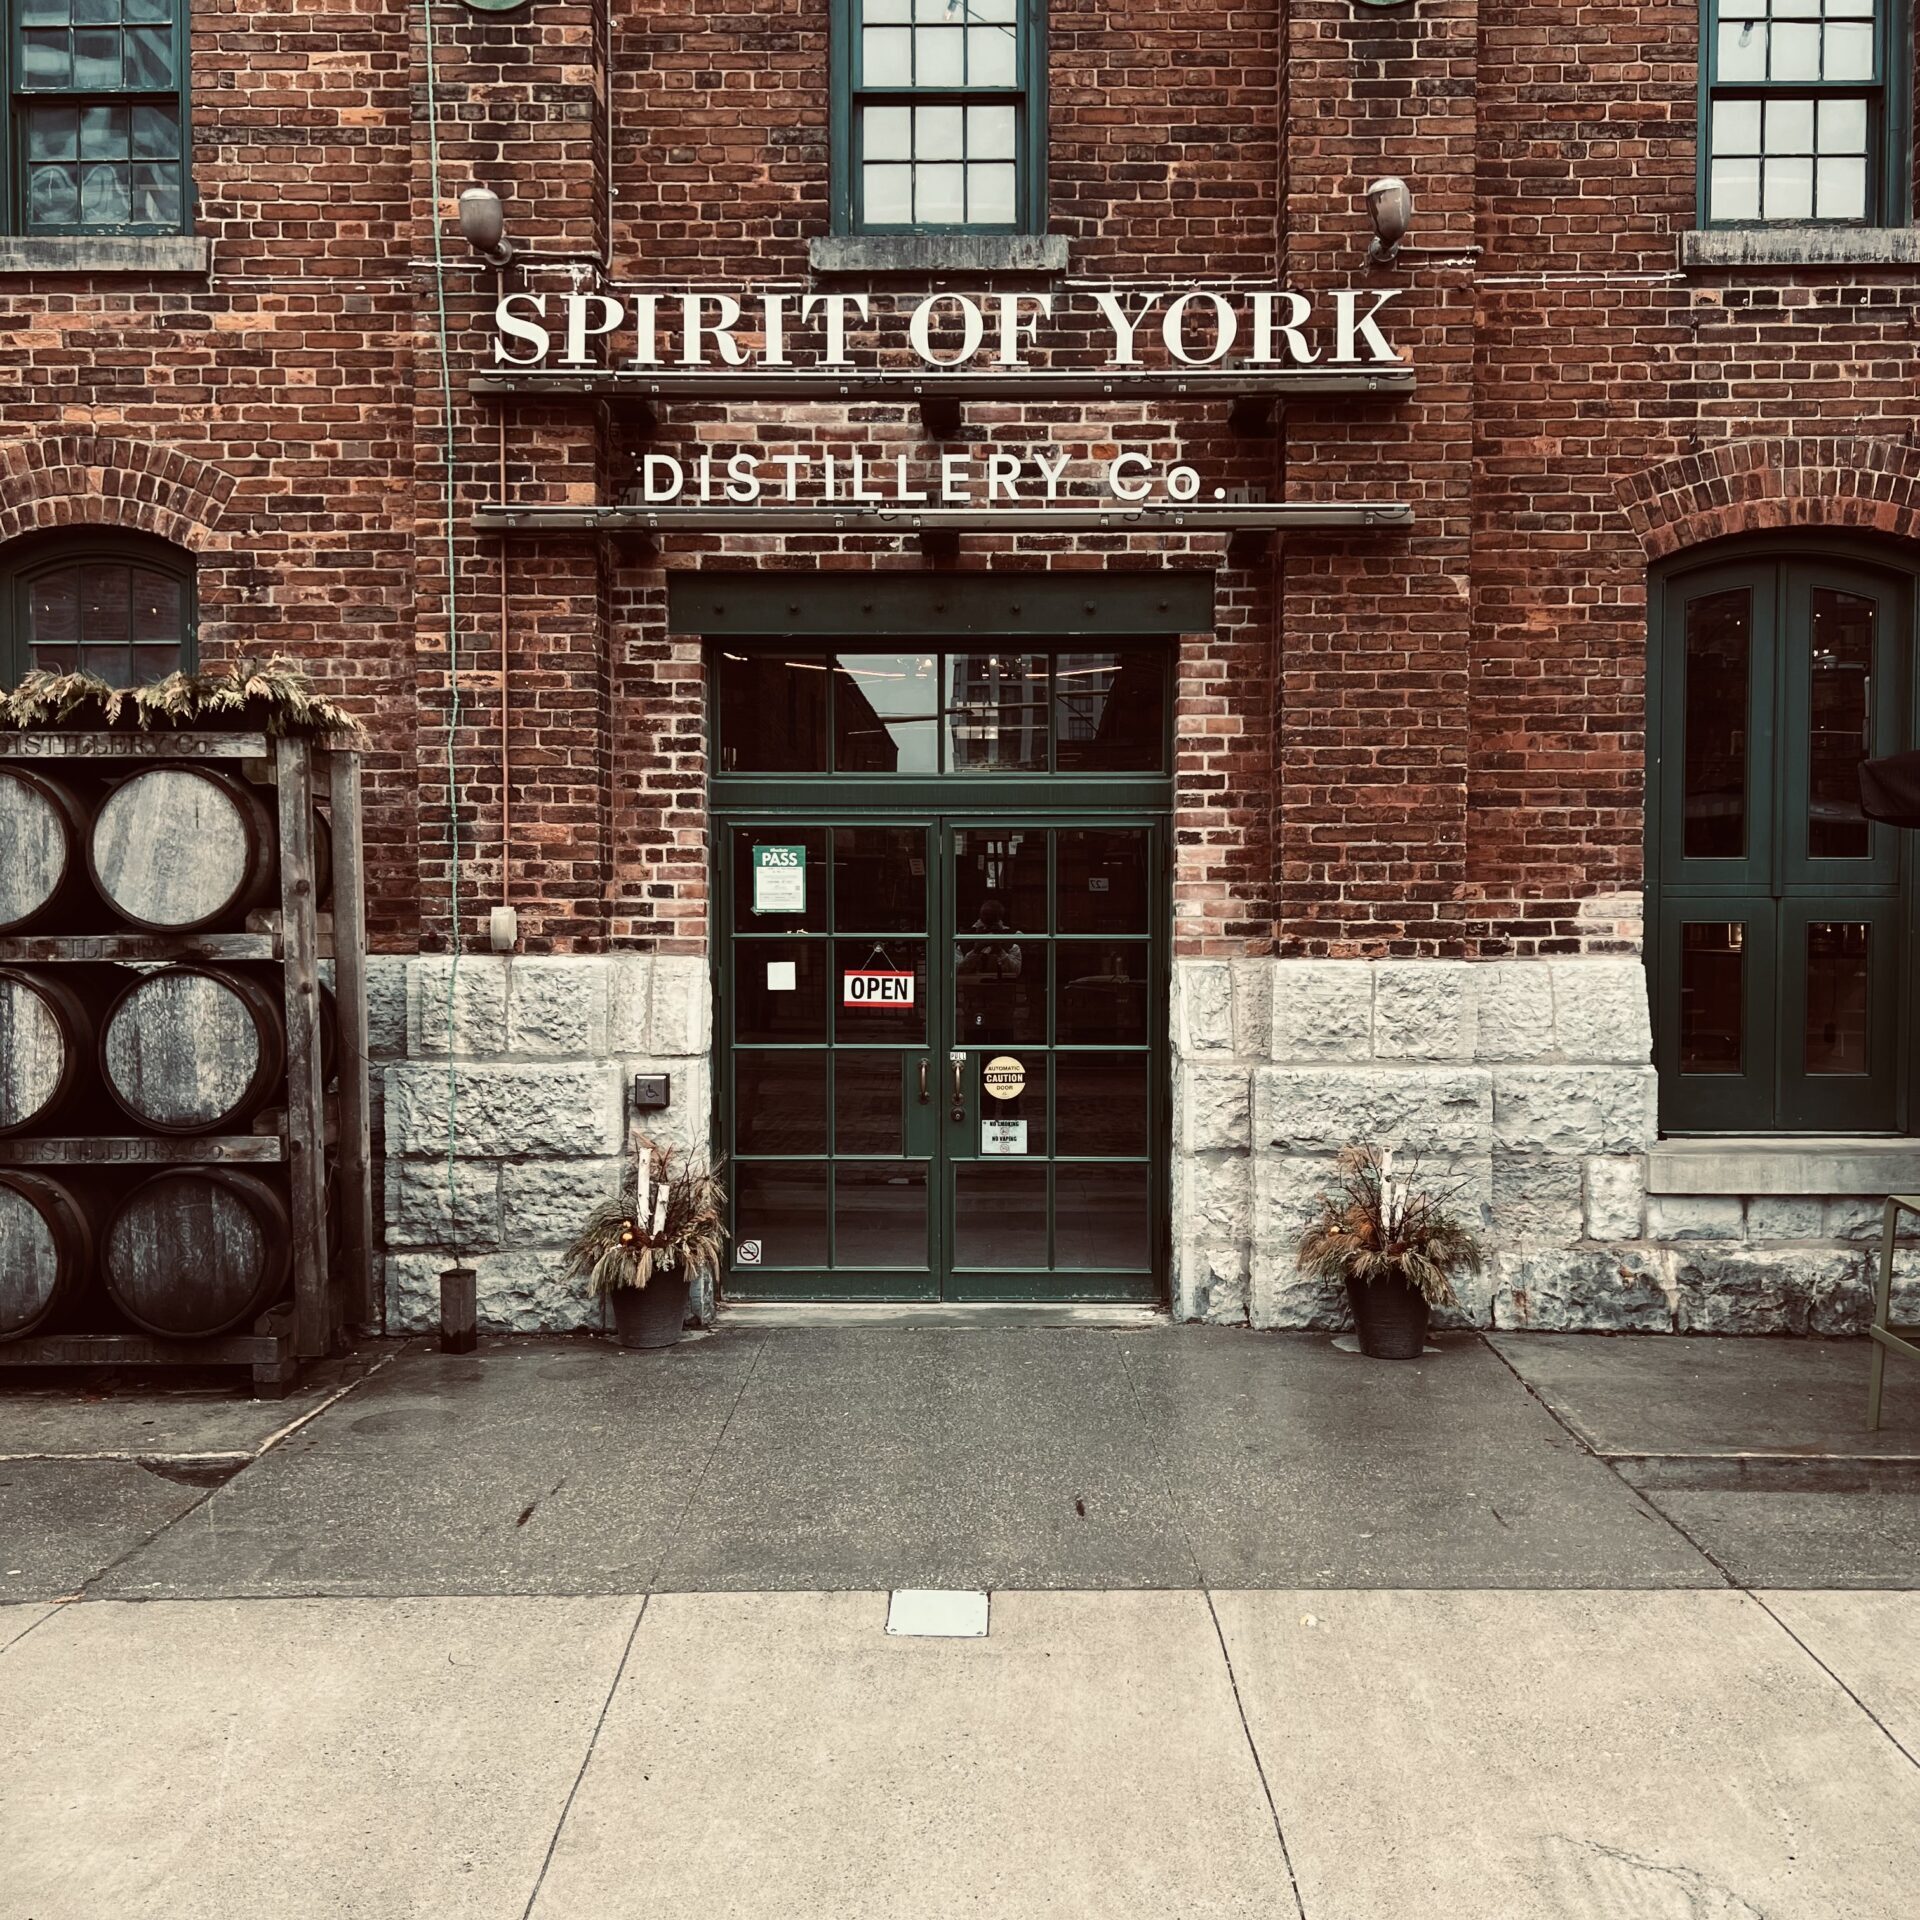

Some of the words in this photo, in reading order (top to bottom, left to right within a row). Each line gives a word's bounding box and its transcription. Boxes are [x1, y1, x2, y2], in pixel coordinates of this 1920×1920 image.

[494, 293, 868, 367] SPIRIT
[909, 292, 1053, 367] OF
[1087, 290, 1405, 365] YORK
[643, 453, 1072, 502] DISTILLERY
[1109, 452, 1227, 502] Co.
[761, 852, 798, 867] PASS
[850, 976, 908, 1000] OPEN
[950, 1051, 966, 1060] PULL
[986, 1073, 1023, 1083] CAUTION
